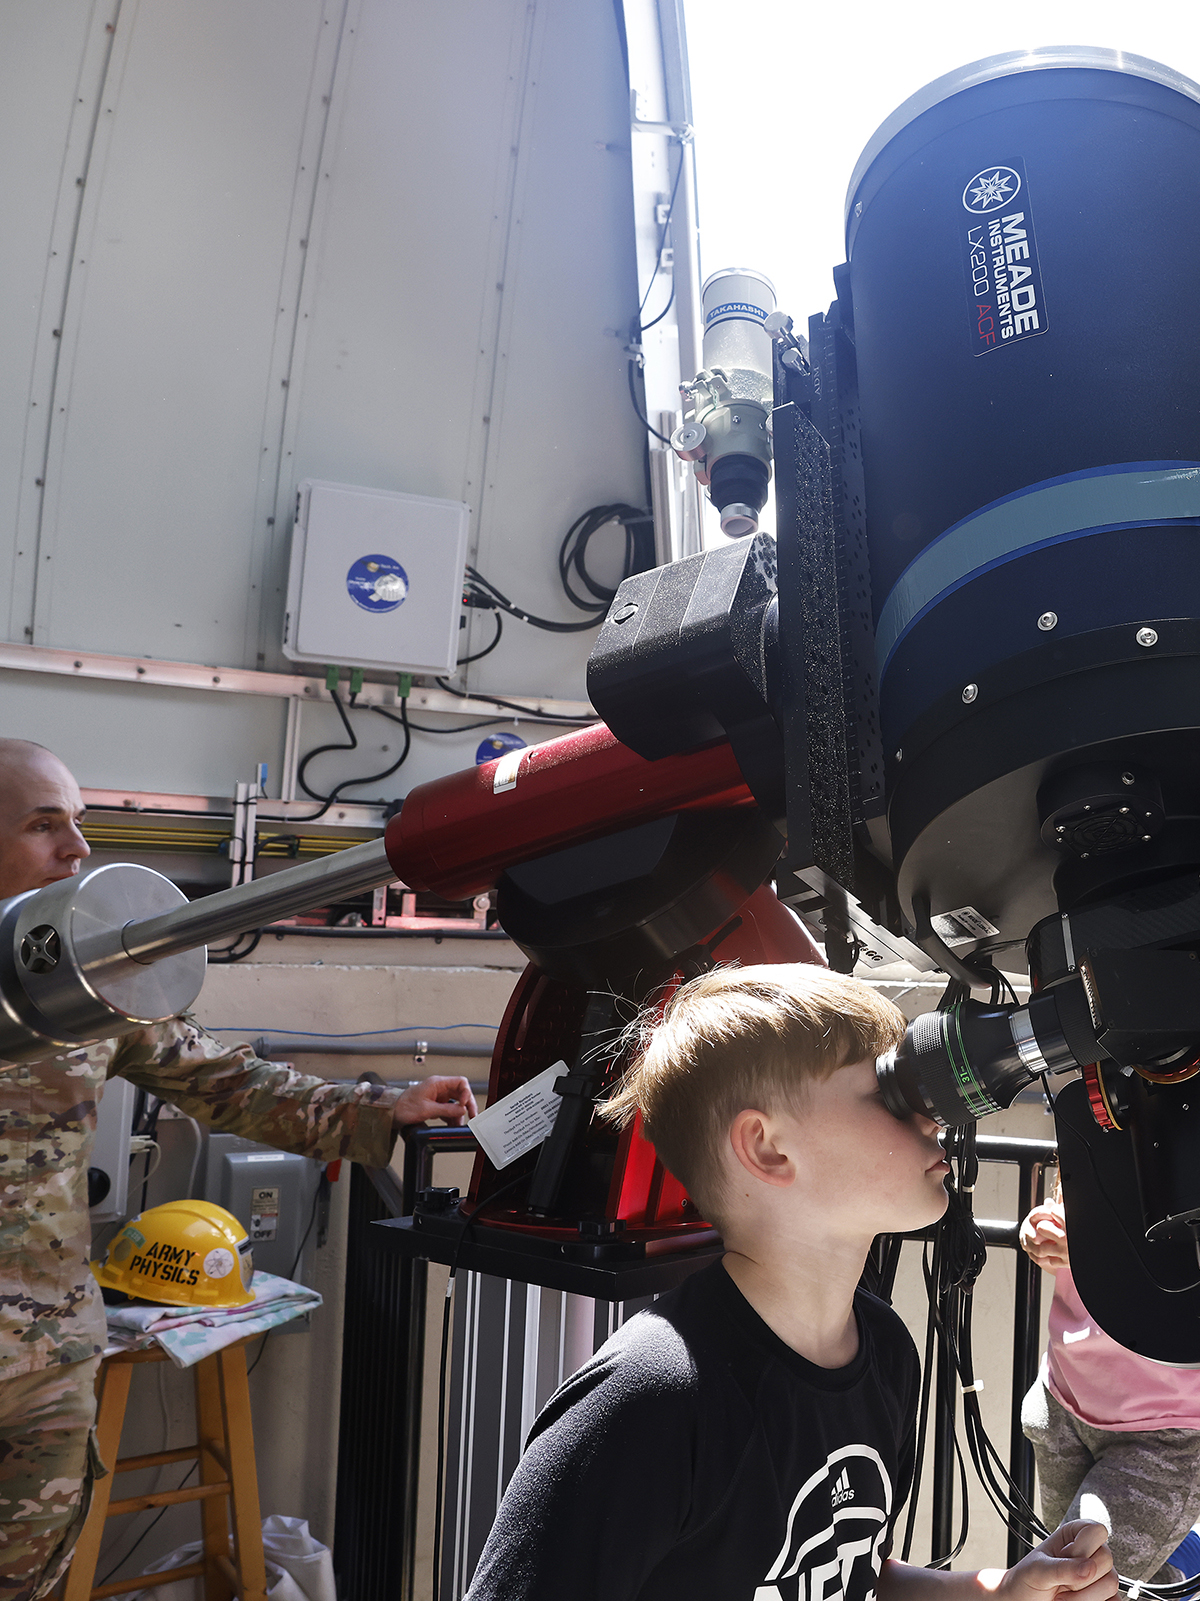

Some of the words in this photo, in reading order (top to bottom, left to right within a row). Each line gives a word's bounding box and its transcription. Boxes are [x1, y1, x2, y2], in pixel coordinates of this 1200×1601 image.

[967, 225, 990, 297] LX200
[1001, 212, 1040, 335] MEADE
[987, 218, 1014, 339] INSTRUMENTS
[709, 304, 764, 318] TAKAHASHI
[976, 304, 996, 346] ACF
[253, 1230, 272, 1239] OFF
[146, 1242, 197, 1266] ARMY
[129, 1255, 200, 1286] PHYSICS
[831, 1488, 855, 1508] adidas
